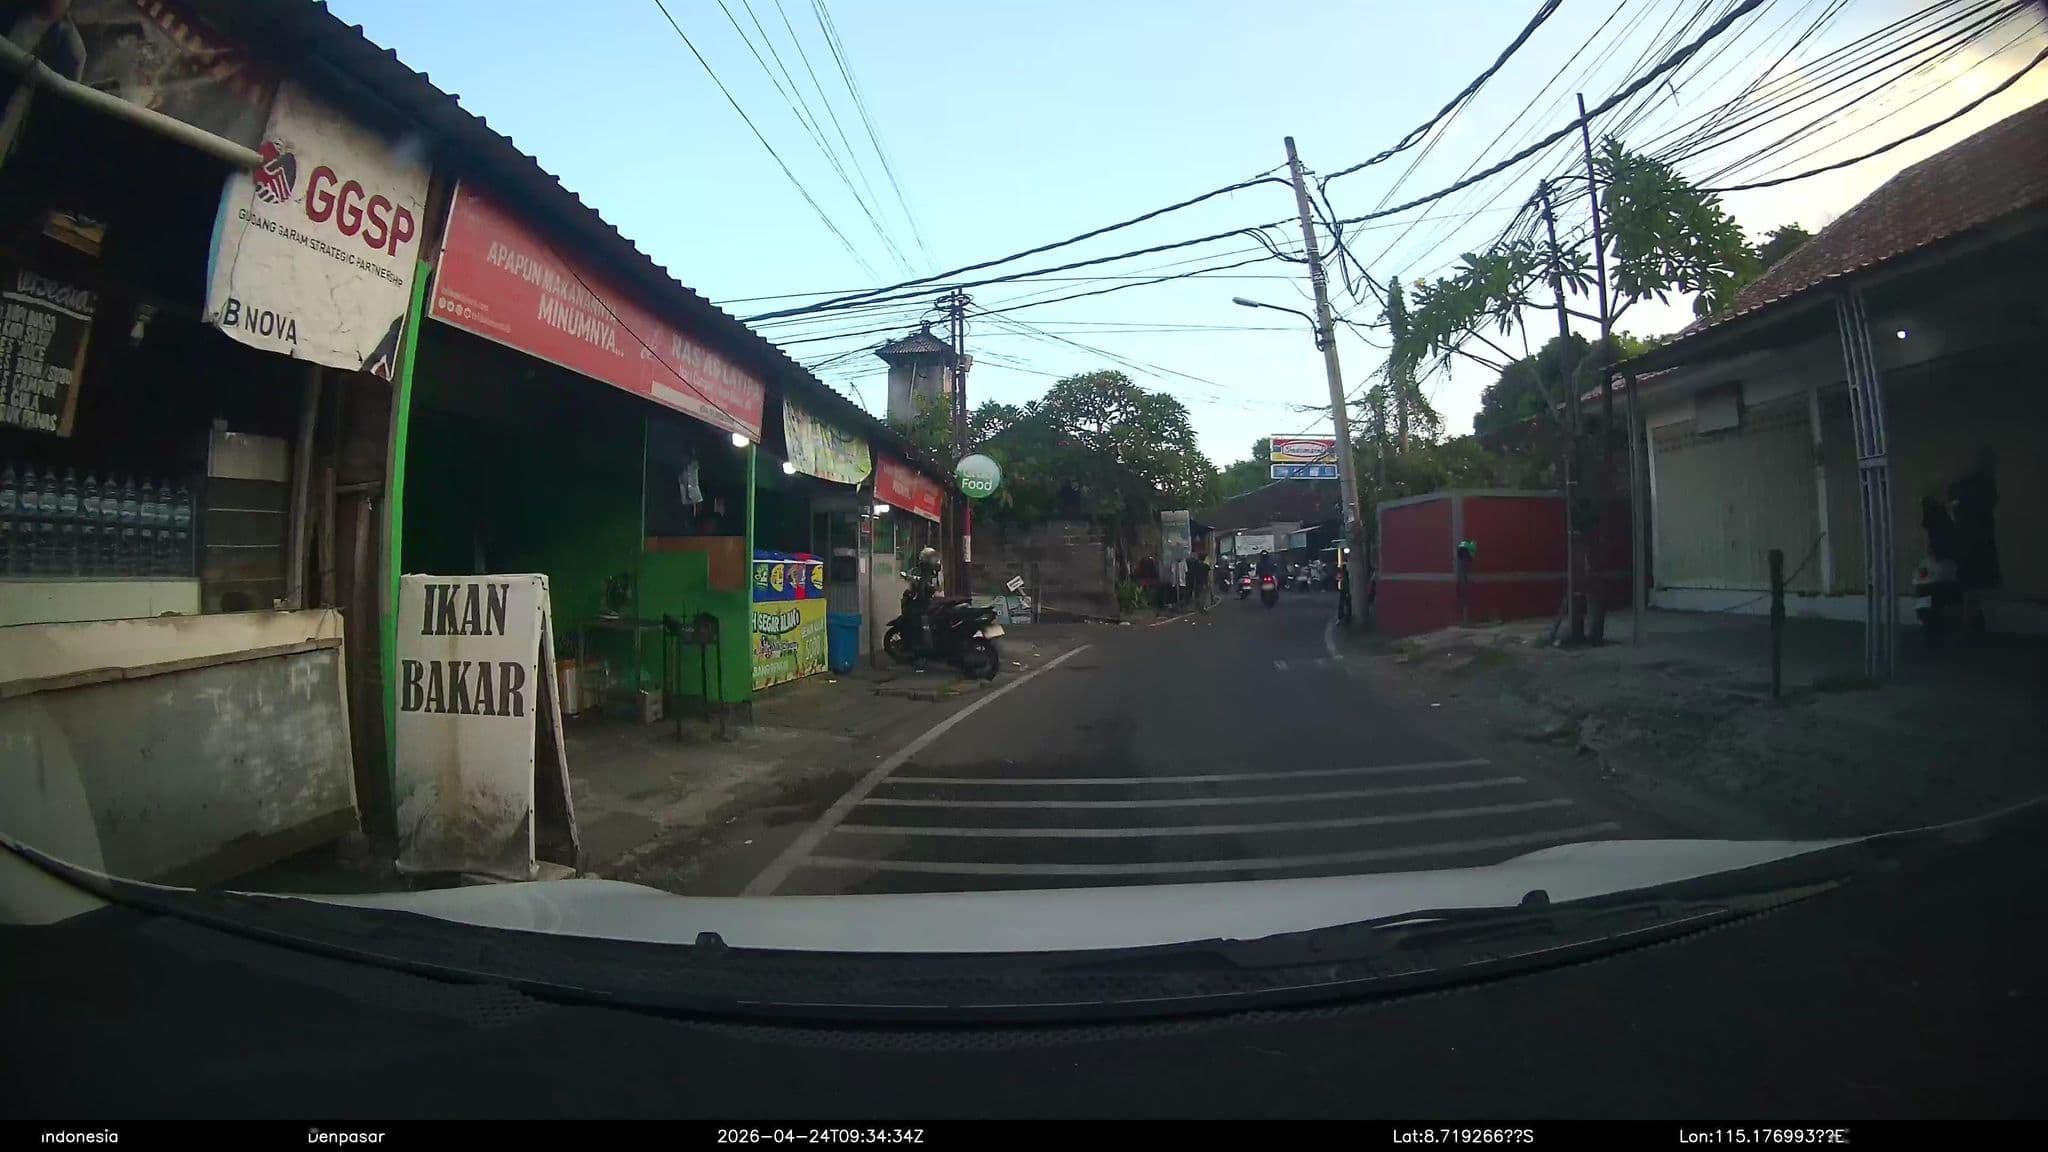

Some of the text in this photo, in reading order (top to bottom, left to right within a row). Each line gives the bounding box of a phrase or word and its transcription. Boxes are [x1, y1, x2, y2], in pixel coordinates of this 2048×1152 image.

[306, 166, 415, 256] GGSP
[278, 224, 308, 246] GARAM
[310, 239, 355, 265] STRATEGIC
[487, 241, 543, 286] APAPUN
[245, 305, 297, 344] NOVA
[962, 478, 993, 491] Food
[421, 584, 510, 635] IKAN
[759, 612, 780, 634] SEGAR
[401, 660, 525, 717] BAKAR
